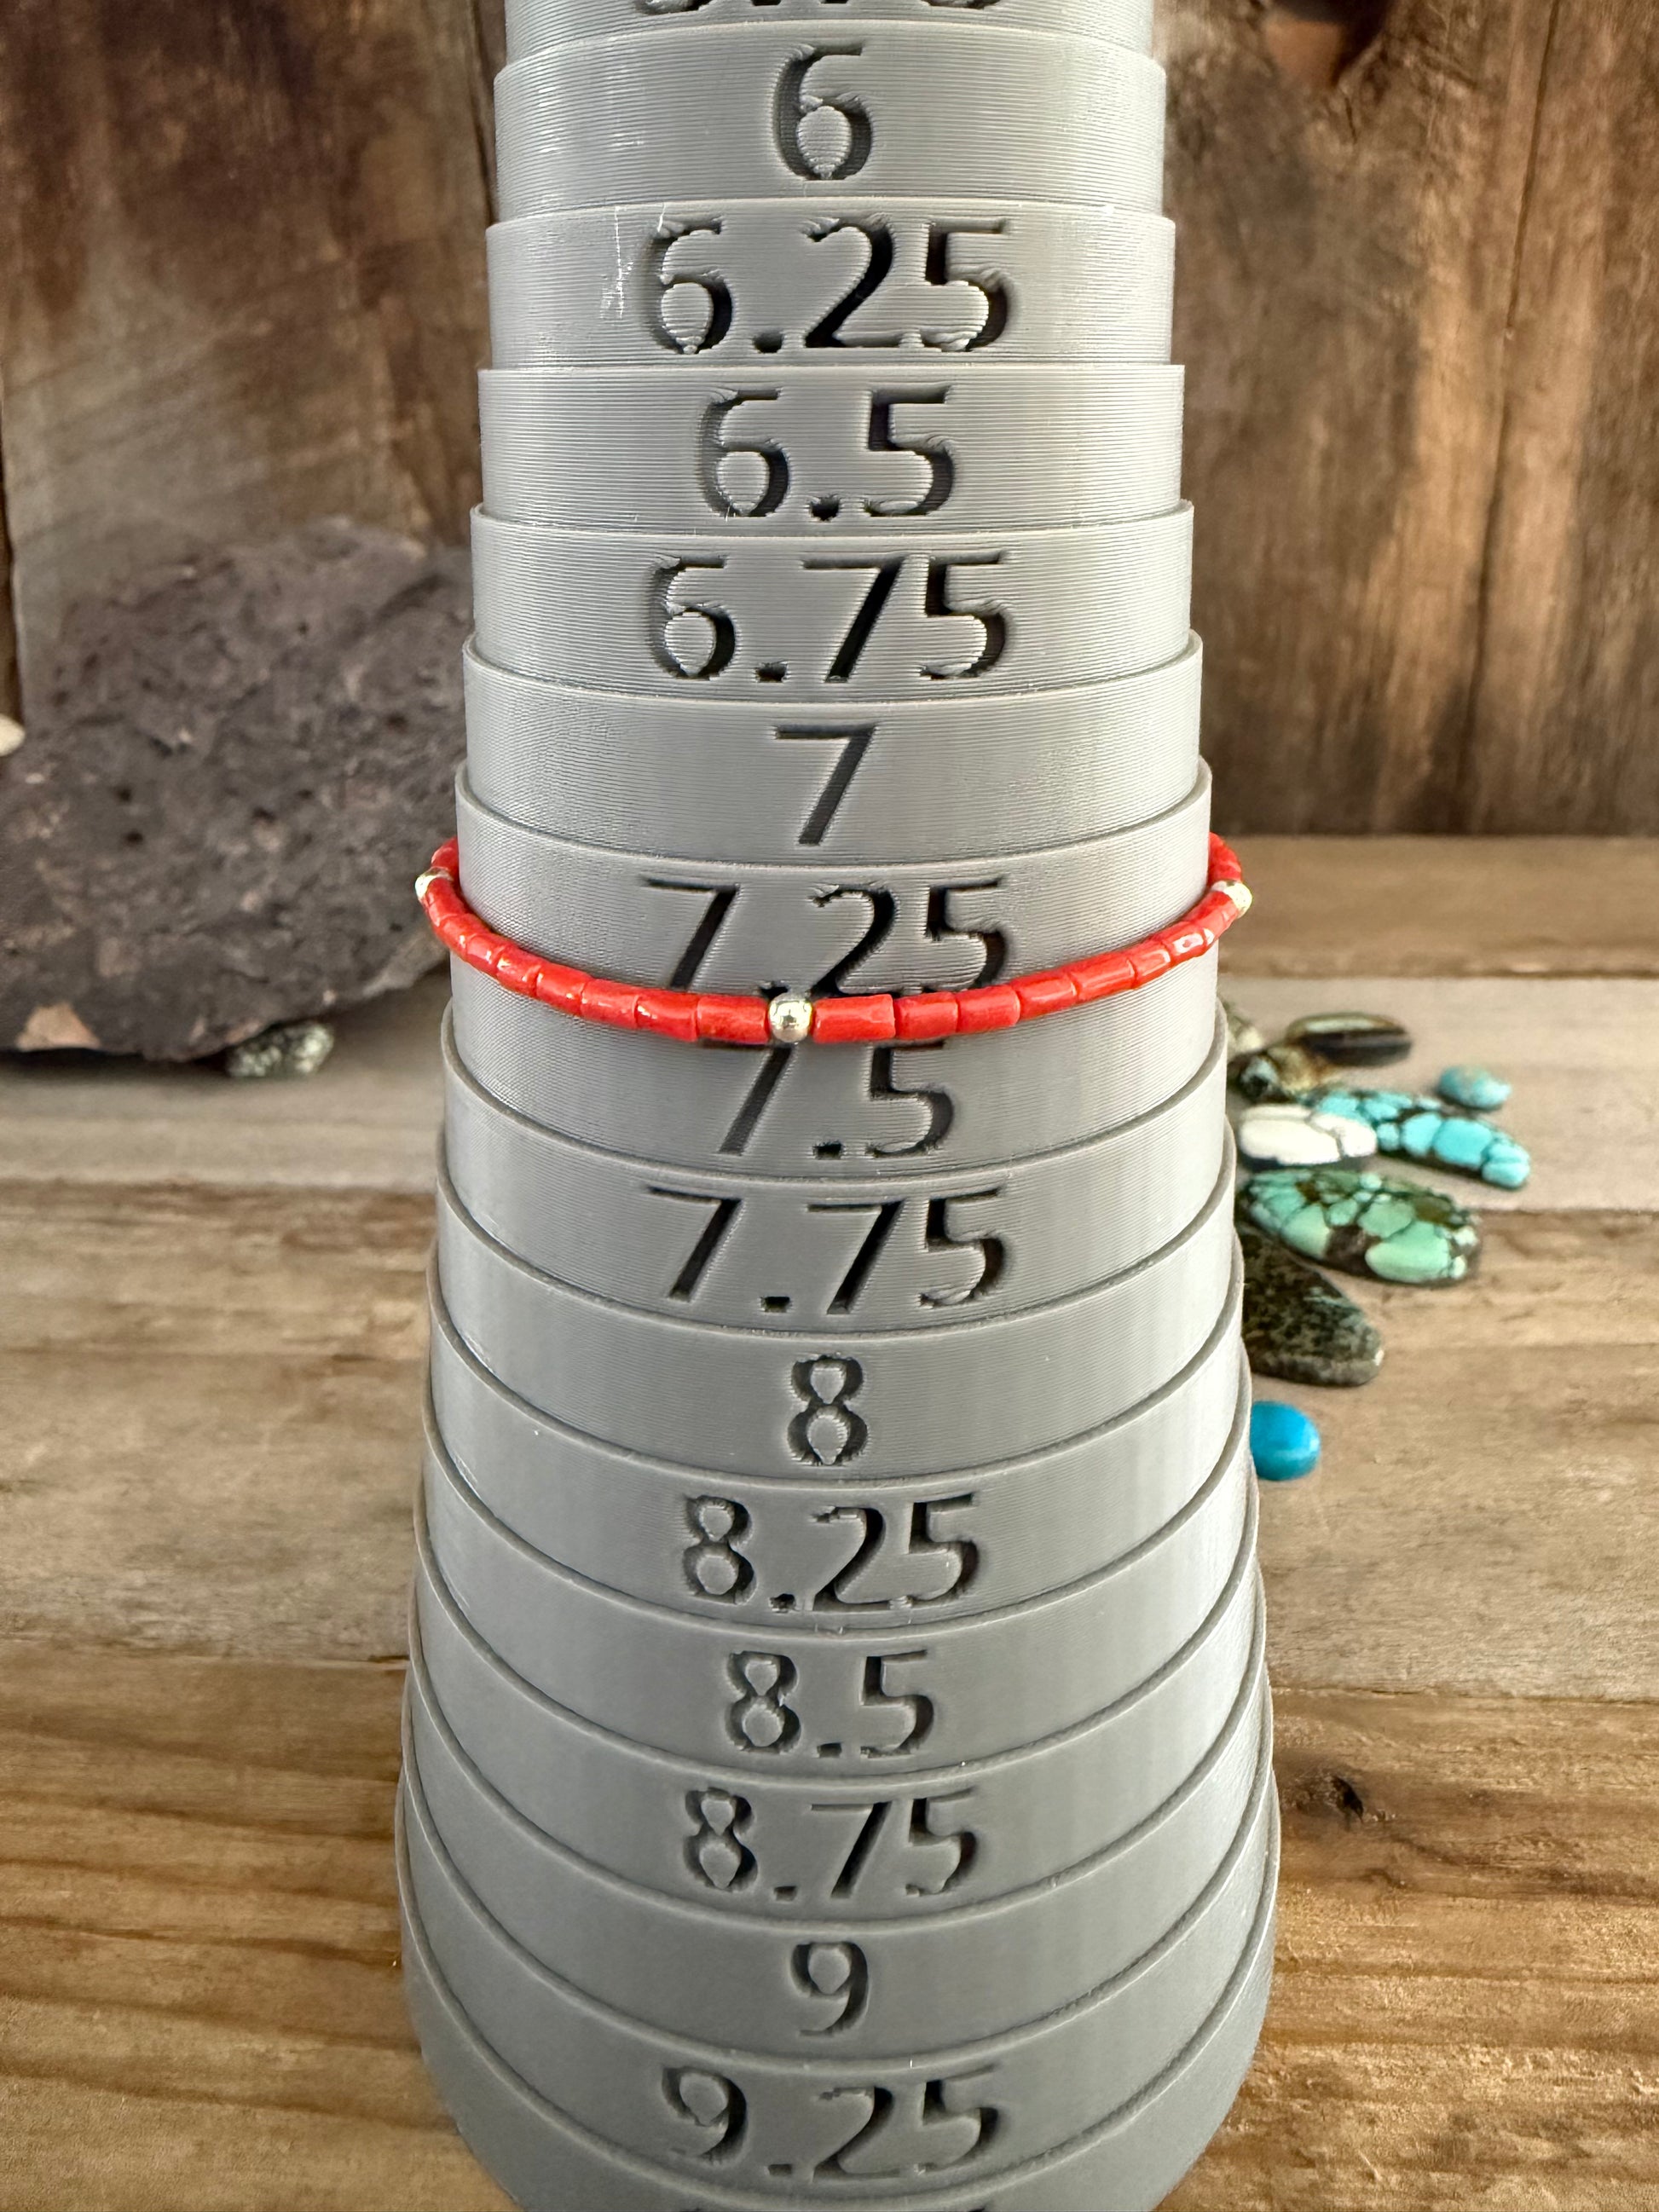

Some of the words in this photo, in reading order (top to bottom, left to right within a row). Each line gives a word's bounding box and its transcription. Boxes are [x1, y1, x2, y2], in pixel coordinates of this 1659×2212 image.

[772, 41, 873, 181] 6
[643, 213, 1018, 353] 6.25
[699, 384, 956, 521] 6.5
[649, 551, 1011, 682] 6.75
[773, 724, 876, 845] 7
[702, 1041, 955, 1158] 7.5
[647, 1186, 1007, 1314] 7.75
[787, 1354, 868, 1465] 8
[683, 1492, 980, 1612] 8.25
[725, 1649, 934, 1759] 8.5
[684, 1786, 978, 1900] 8.75
[790, 1942, 868, 2036] 9
[662, 2064, 999, 2182] 9.25
